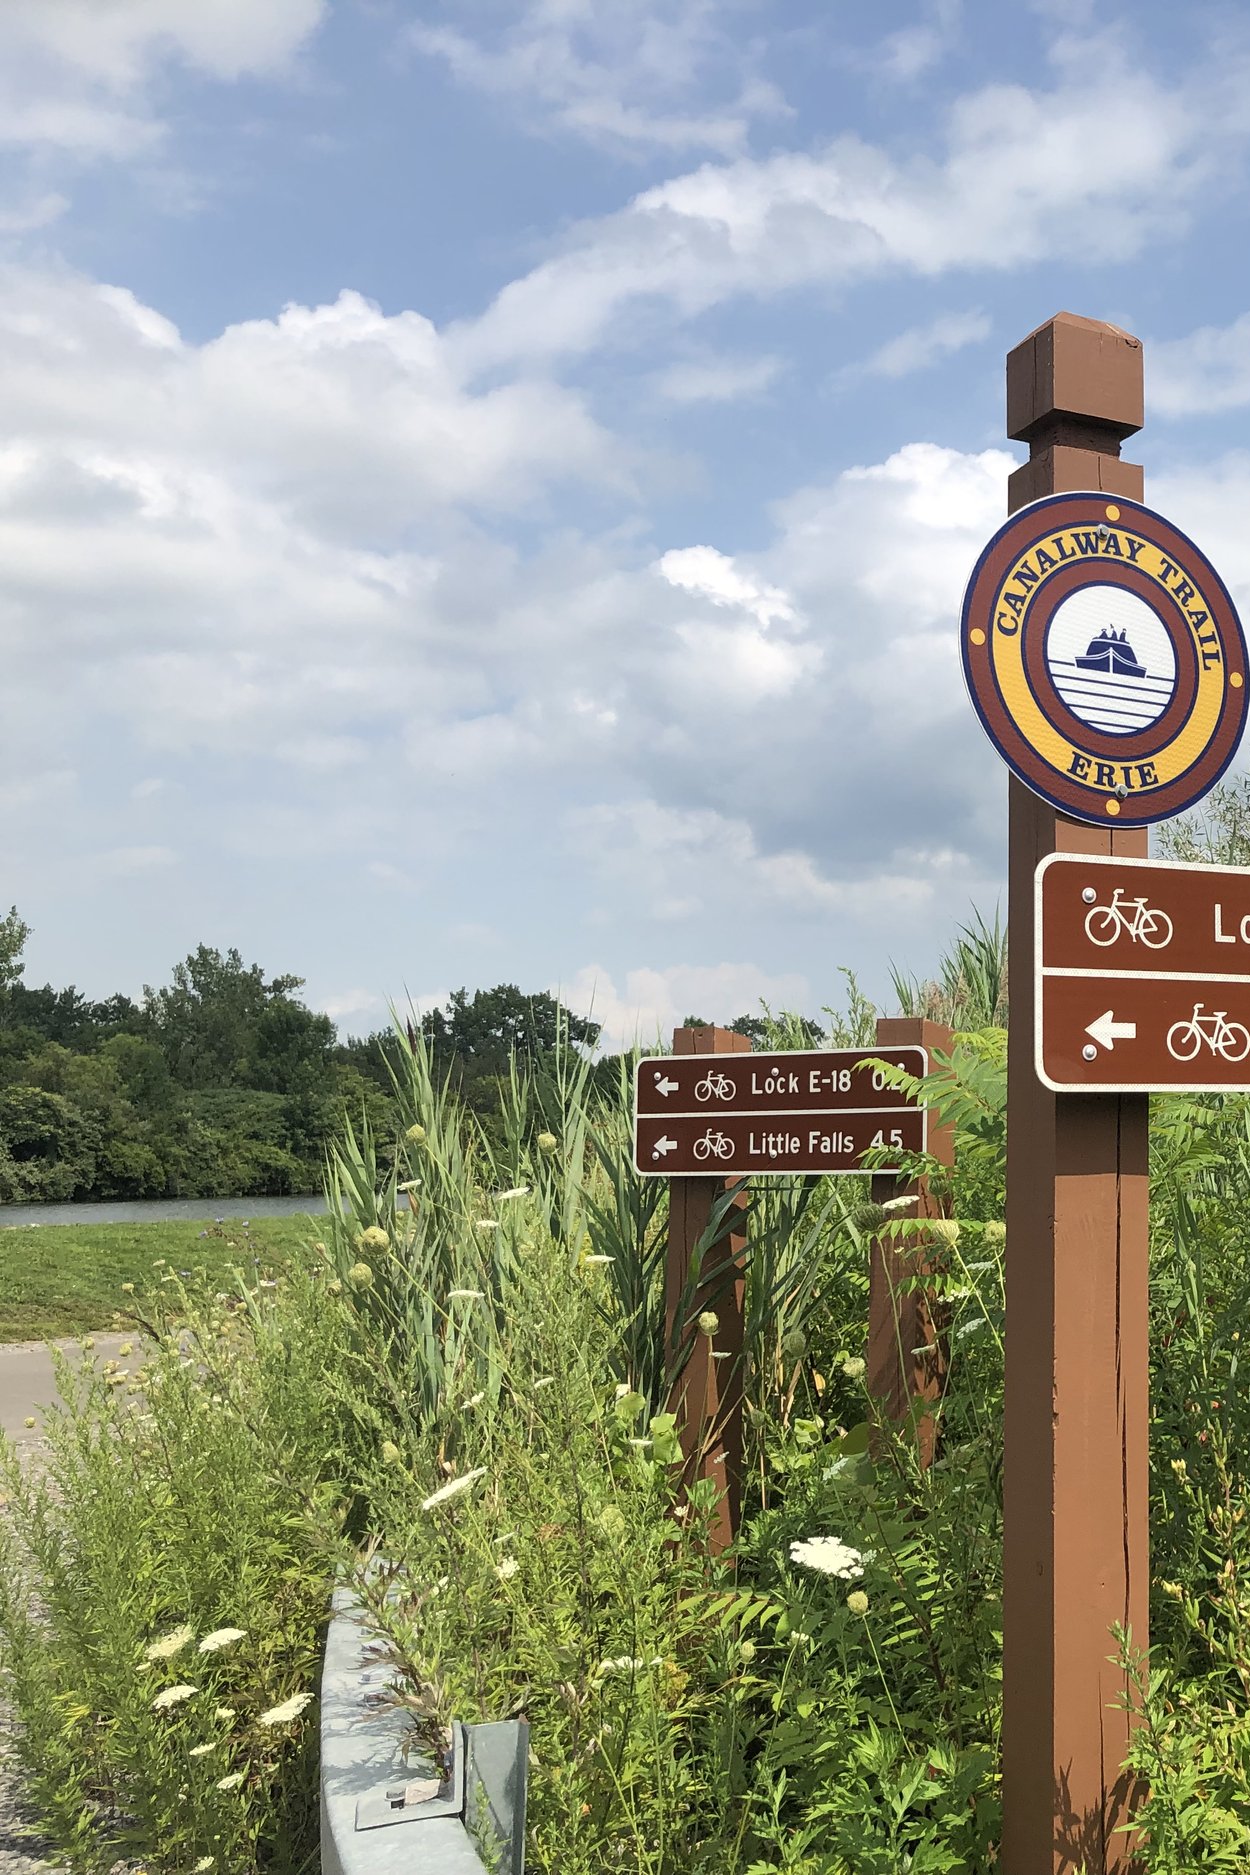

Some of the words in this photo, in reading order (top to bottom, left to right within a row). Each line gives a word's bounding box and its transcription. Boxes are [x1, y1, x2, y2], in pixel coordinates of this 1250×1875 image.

[996, 531, 1146, 637] CANALWAY
[1157, 558, 1221, 672] TRAIL
[1066, 751, 1159, 790] ERIE
[751, 1073, 799, 1095] Lock
[809, 1070, 851, 1093] E-18
[749, 1133, 801, 1154] Little
[809, 1131, 854, 1153] Falls
